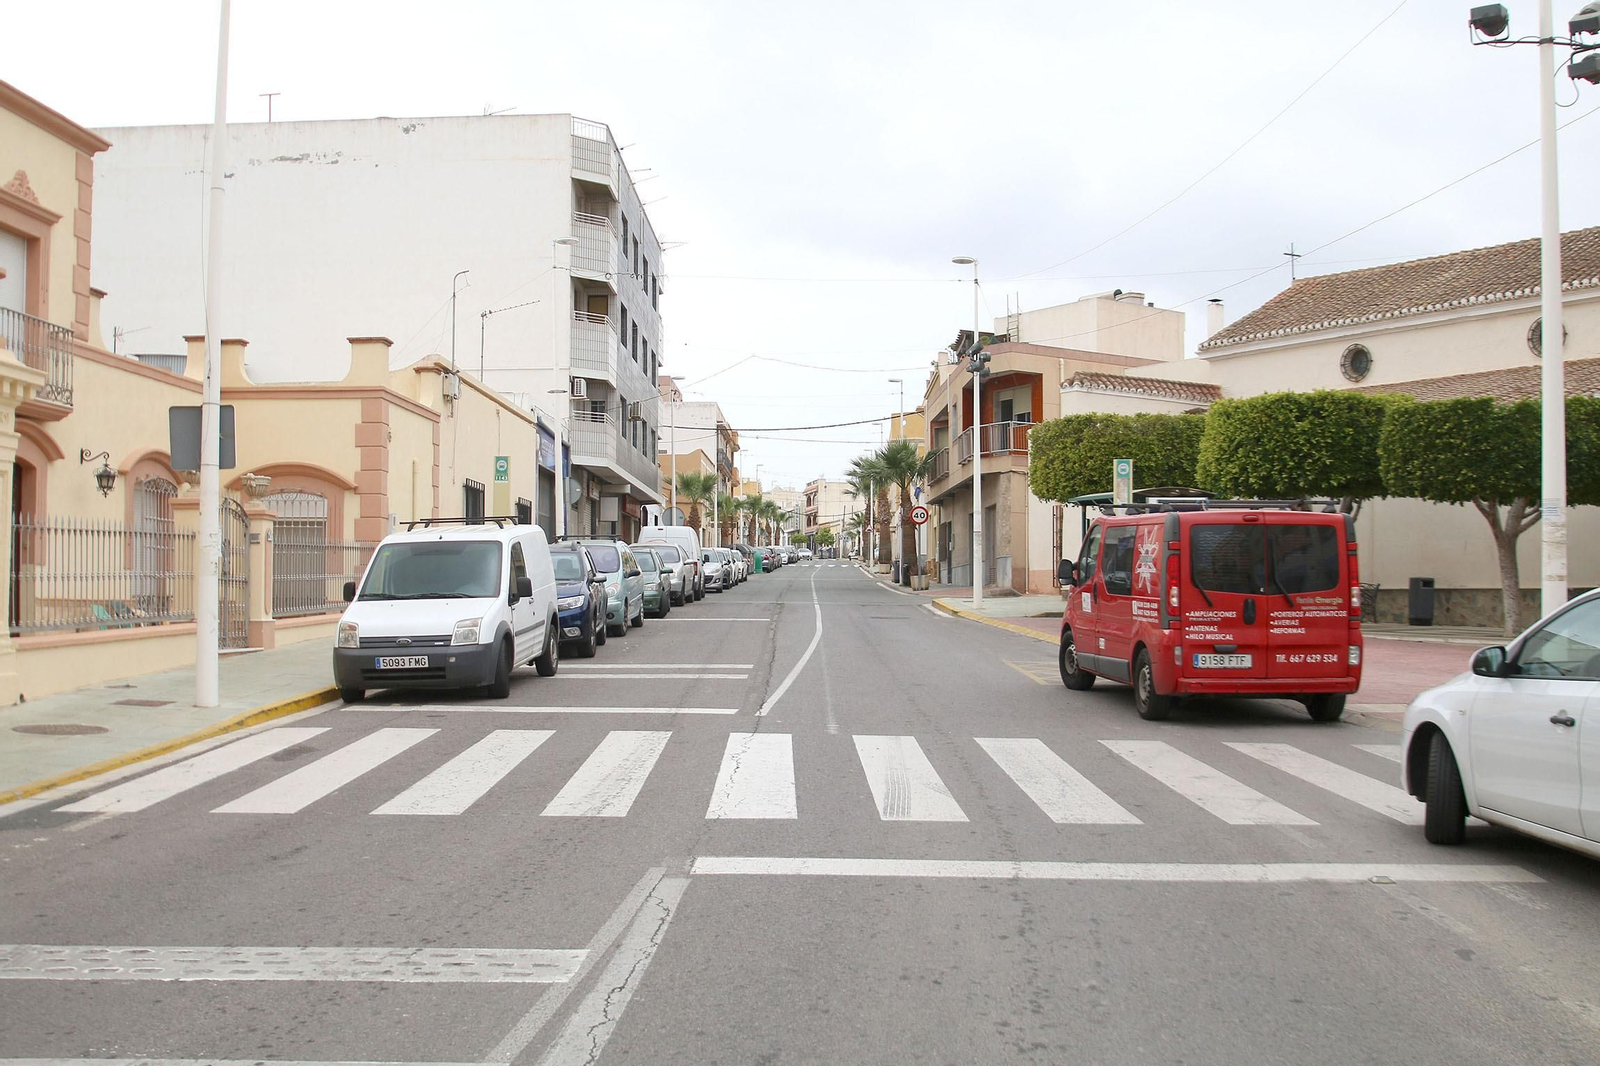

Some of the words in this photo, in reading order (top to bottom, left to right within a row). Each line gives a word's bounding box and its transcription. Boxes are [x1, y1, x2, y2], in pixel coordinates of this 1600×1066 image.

[1205, 633, 1234, 641] MUSICAL
[382, 657, 406, 668] 5093
[408, 657, 427, 667] FMG
[1200, 655, 1225, 666] 9158
[1228, 655, 1246, 666] FTF
[1289, 654, 1305, 663] 667
[1306, 654, 1321, 663] 629
[1323, 654, 1339, 663] 534
